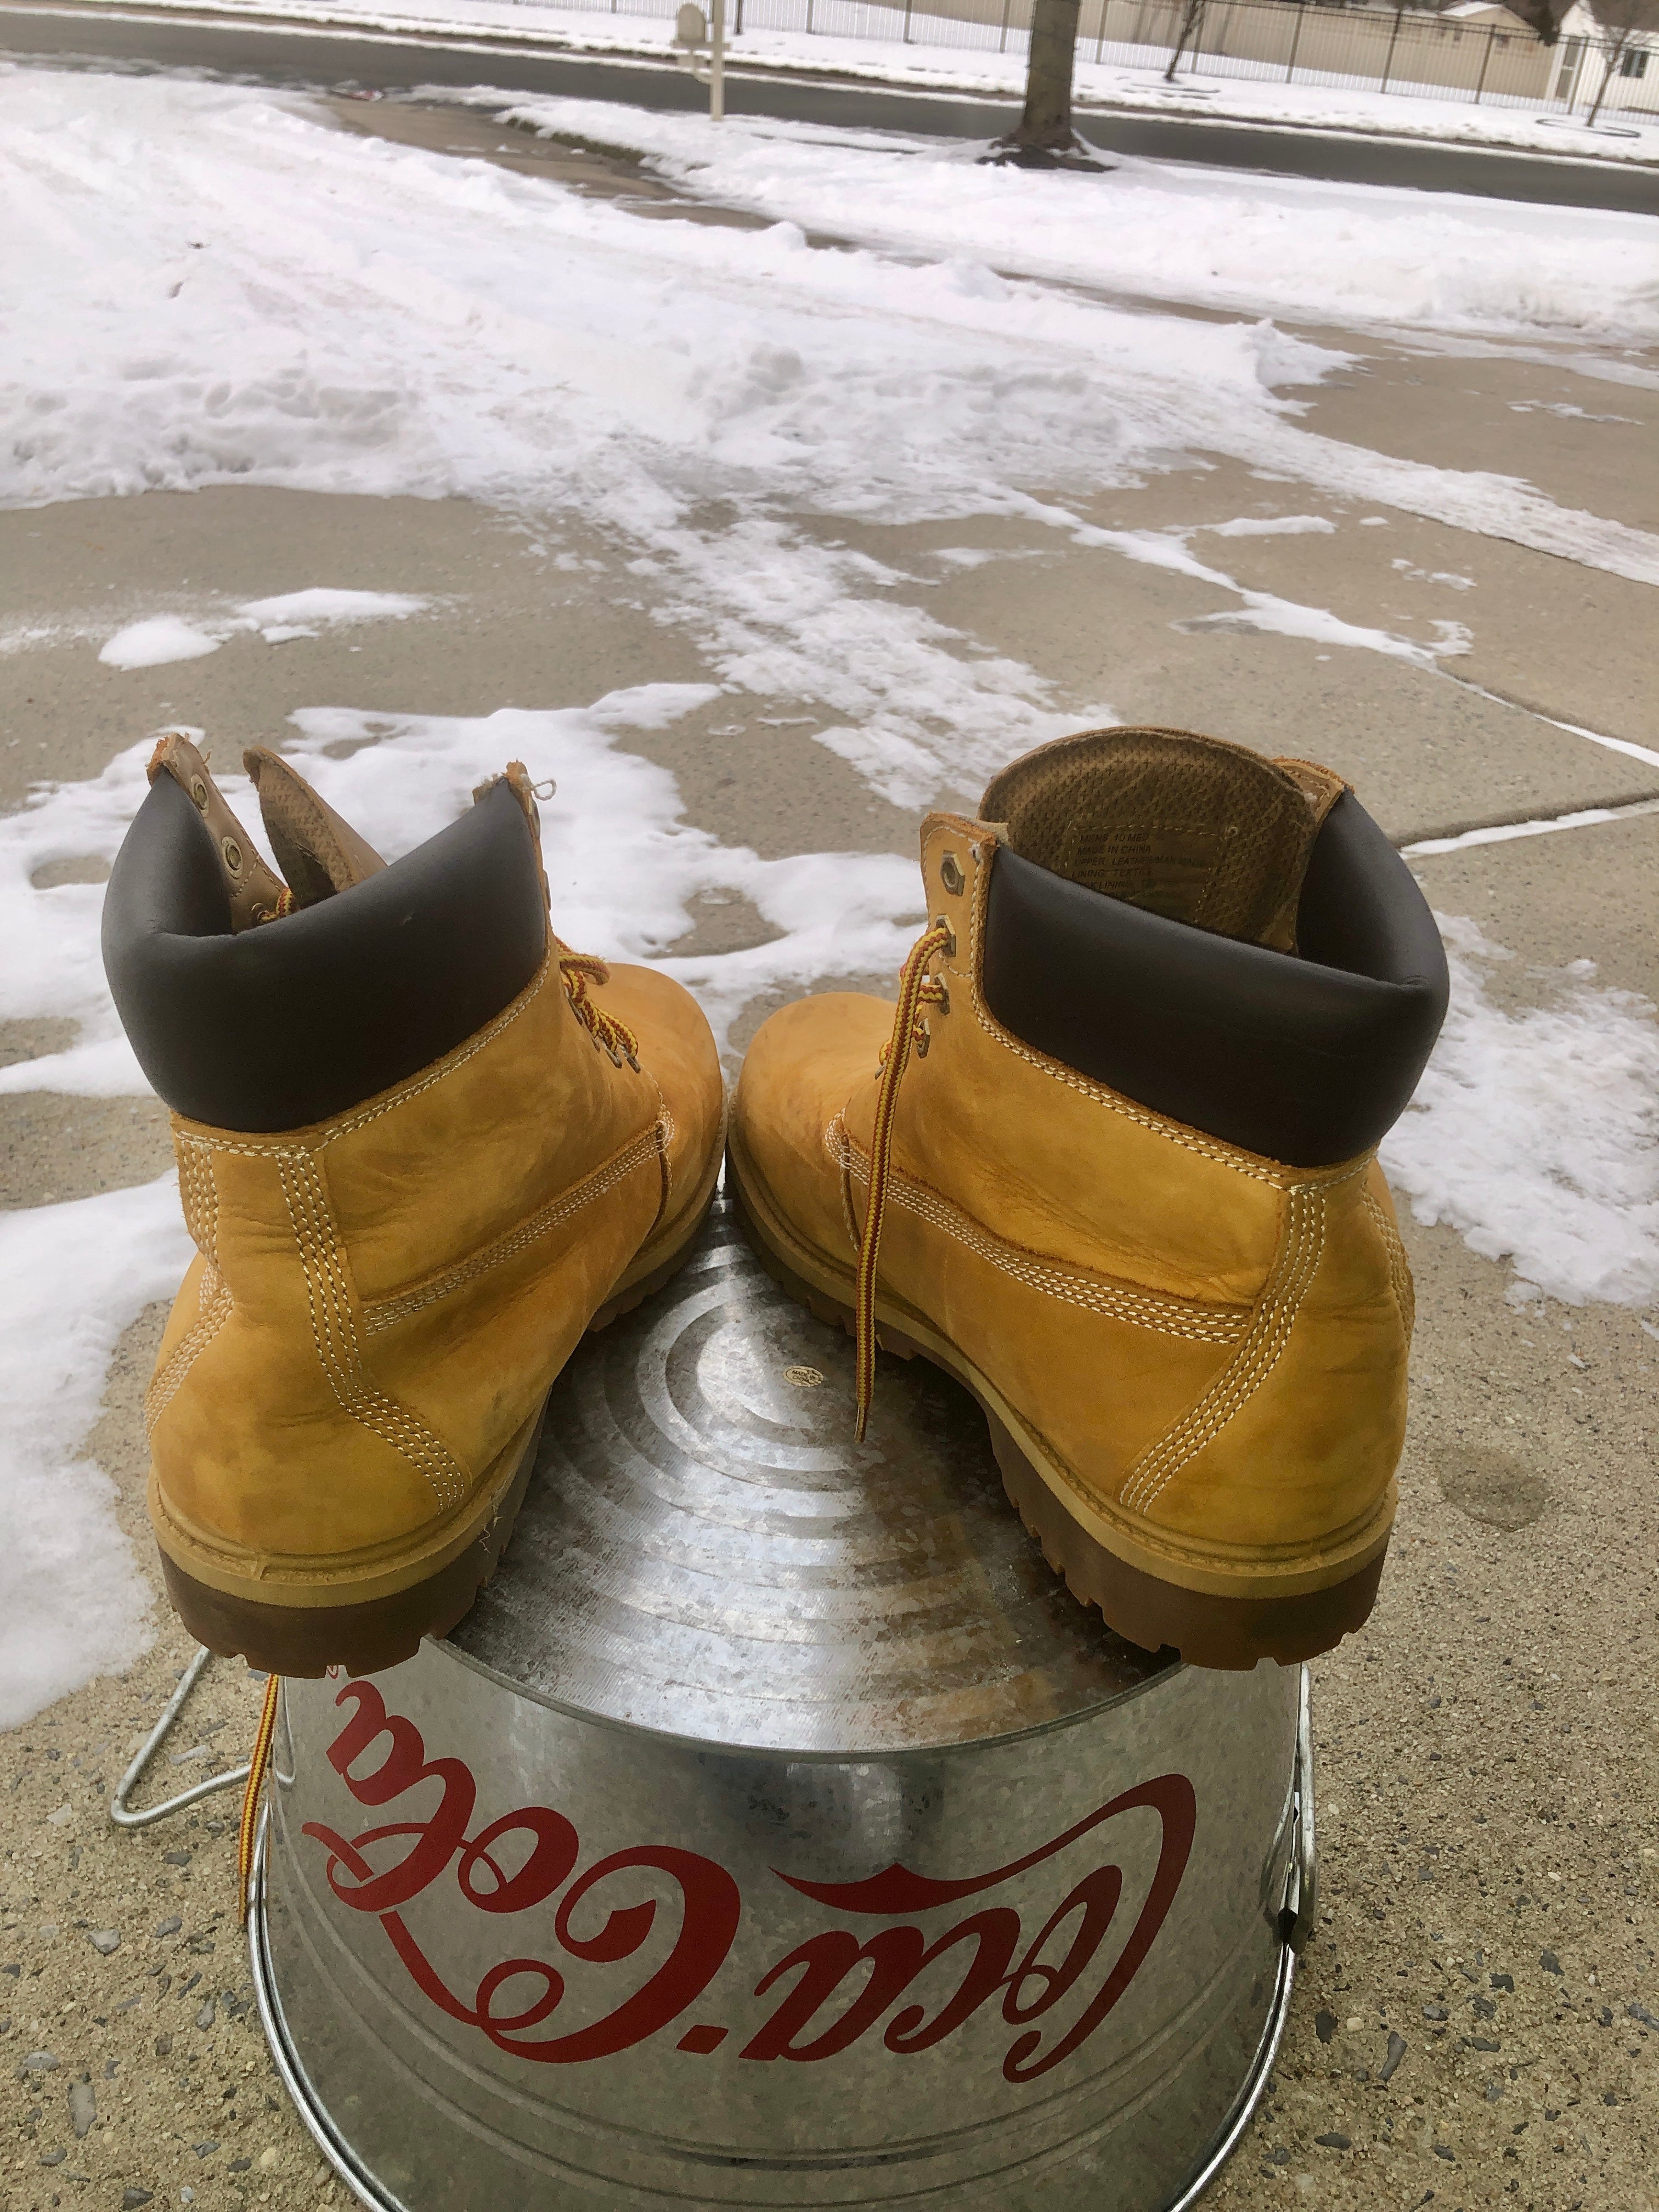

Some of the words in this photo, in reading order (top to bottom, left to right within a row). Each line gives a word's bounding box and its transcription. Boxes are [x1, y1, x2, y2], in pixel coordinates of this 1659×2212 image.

[1114, 833, 1124, 842] 10
[1127, 833, 1149, 842] MED
[1076, 845, 1105, 855] MADE
[1108, 845, 1118, 854] IN
[1121, 844, 1151, 854] CHINA
